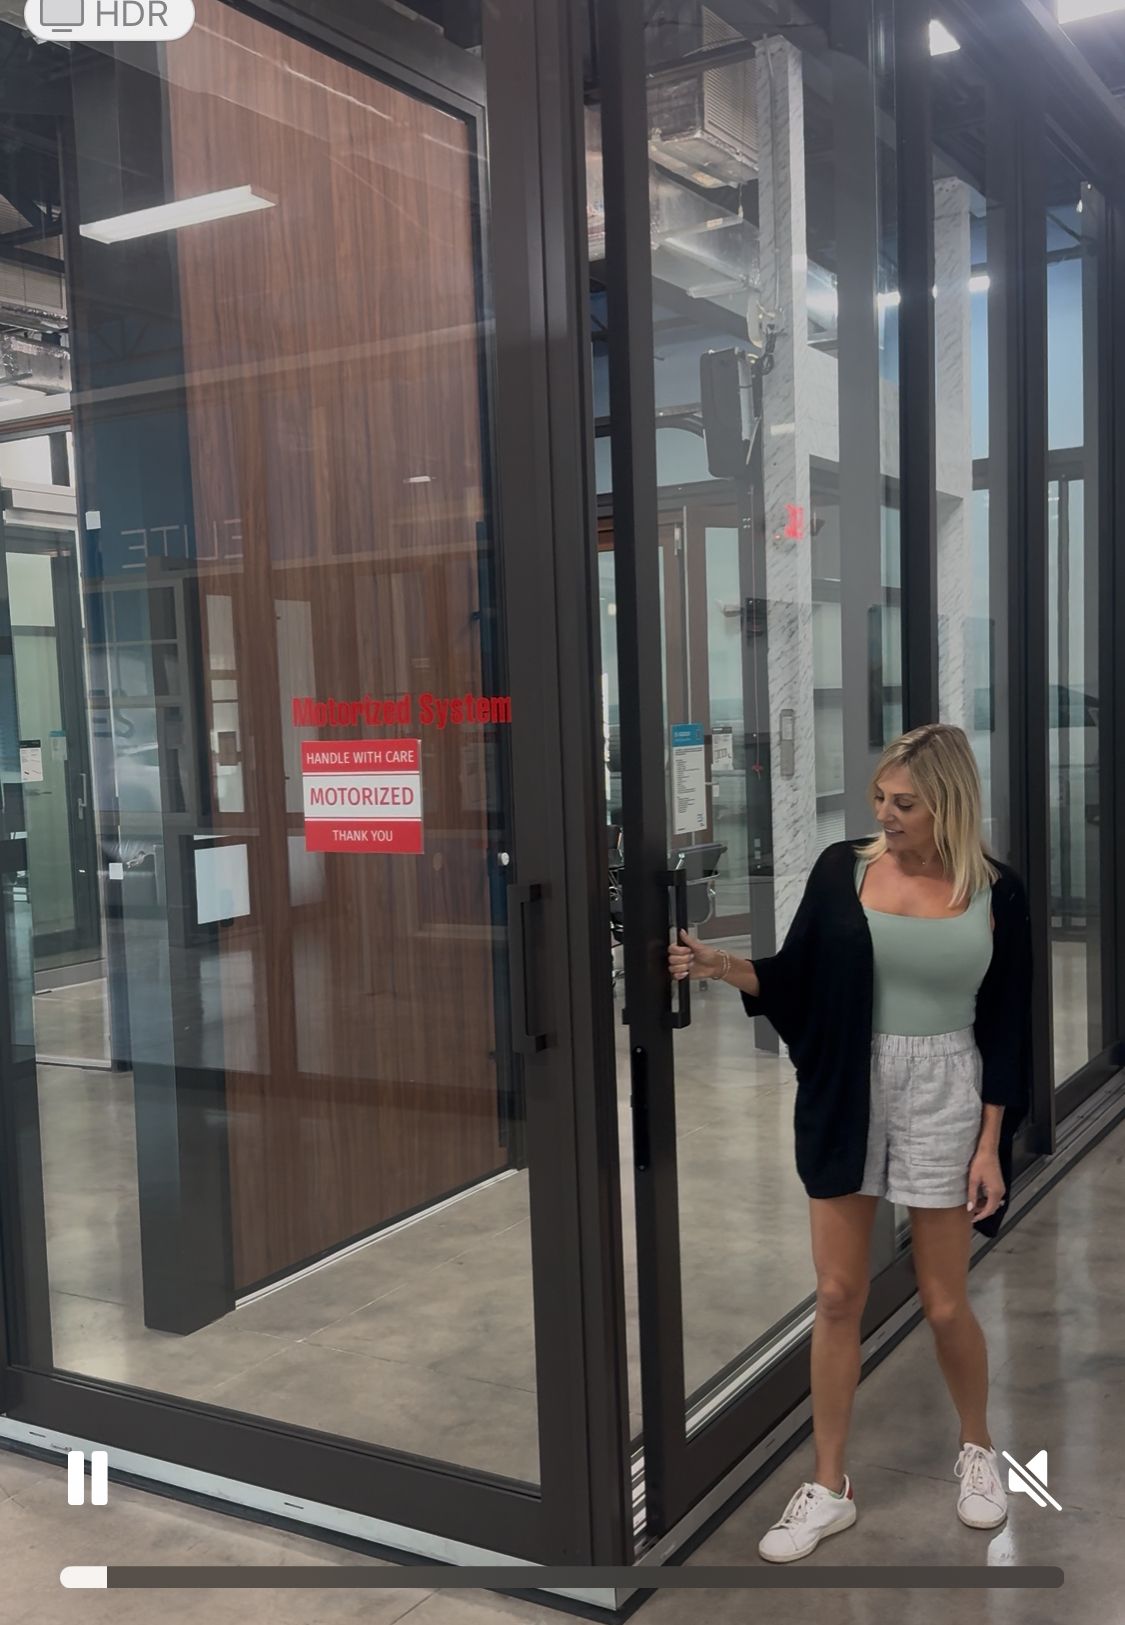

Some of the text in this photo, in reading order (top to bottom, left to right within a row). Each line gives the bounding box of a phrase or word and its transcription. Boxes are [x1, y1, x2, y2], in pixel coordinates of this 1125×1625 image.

[291, 692, 512, 729] Motorized System
[306, 750, 414, 764] HANDLE WITH CARE
[310, 787, 414, 806] MOTORIZED
[332, 829, 393, 842] THANK YOU
